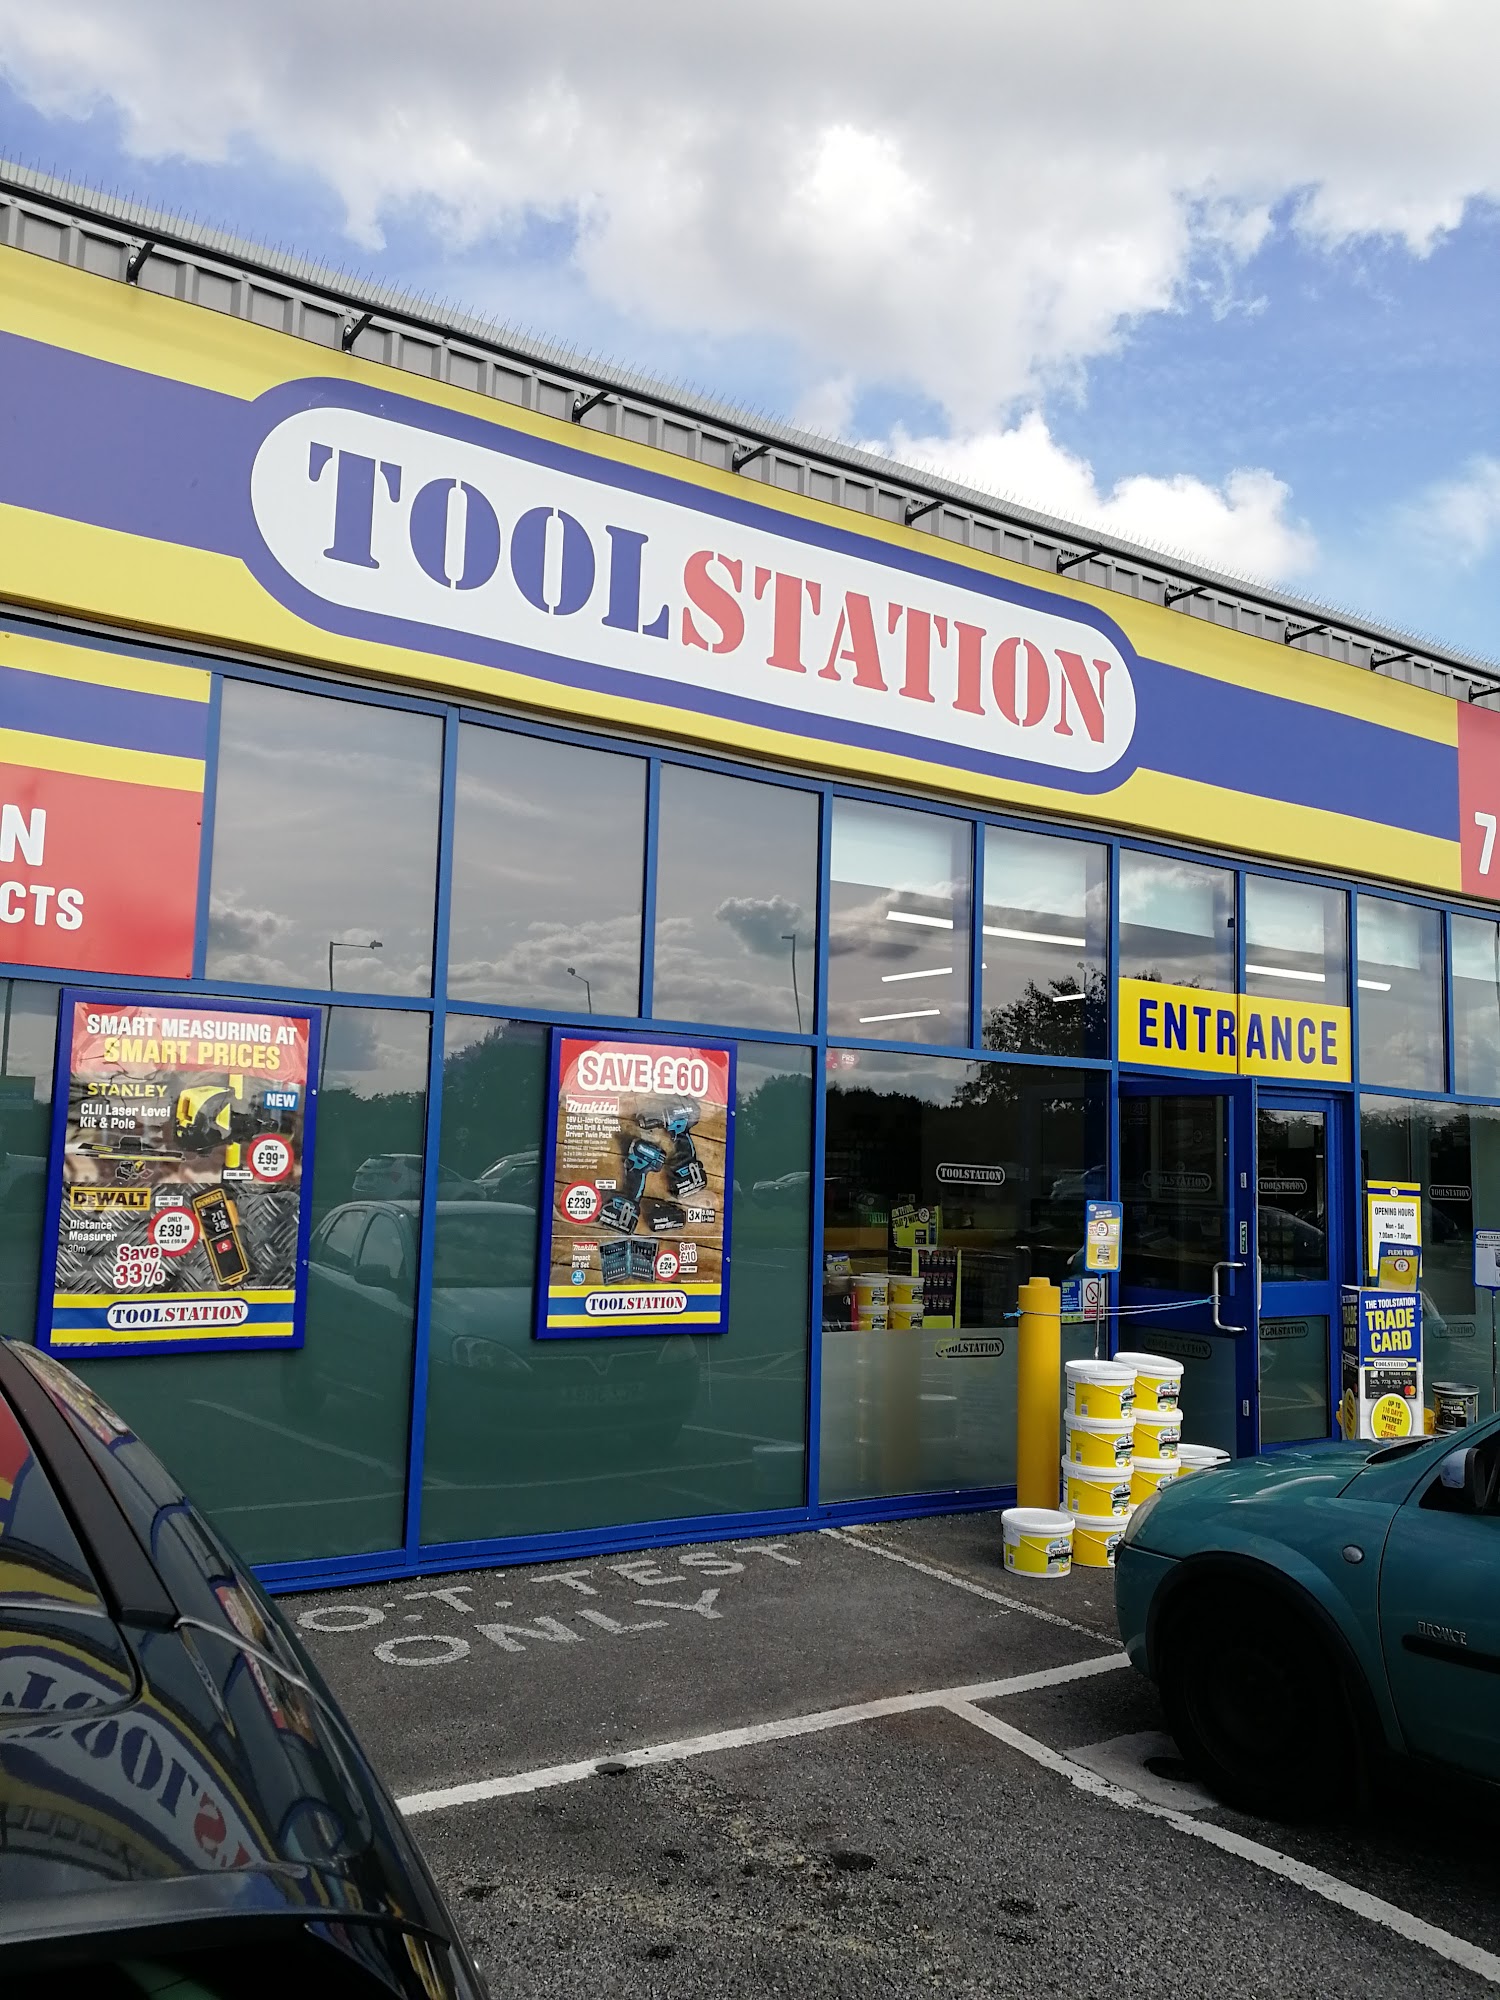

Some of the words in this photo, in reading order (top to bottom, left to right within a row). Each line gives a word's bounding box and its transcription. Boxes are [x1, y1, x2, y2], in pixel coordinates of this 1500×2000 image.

[309, 441, 1112, 744] TOOLSTATION
[1475, 811, 1497, 875] 7
[0, 880, 85, 931] CTS
[87, 1014, 156, 1037] SMART
[161, 1018, 271, 1043] MEASURING
[276, 1027, 297, 1046] AT
[1139, 998, 1338, 1065] ENTRANCE
[104, 1037, 191, 1064] SMART
[197, 1043, 281, 1070] PRICES
[582, 1055, 649, 1088] SAVE
[657, 1061, 702, 1092] £60
[87, 1083, 167, 1098] STANLEY
[266, 1093, 296, 1108] NEW
[105, 1104, 139, 1117] Laser
[141, 1106, 171, 1118] Level
[79, 1116, 98, 1128] Kit
[99, 1118, 108, 1129] &
[110, 1118, 136, 1130] Pole
[940, 1168, 1002, 1181] TOOLSTATION
[1374, 1206, 1397, 1216] OPENING
[1398, 1207, 1415, 1217] HOURS
[70, 1219, 112, 1231] Distance
[1385, 1222, 1394, 1230] Mon
[69, 1231, 117, 1242] Measurer
[118, 1245, 159, 1262] Save
[681, 1243, 695, 1251] Save
[680, 1252, 696, 1262] £10
[114, 1263, 163, 1286] 33%
[589, 1296, 684, 1311] TOOLSTATION
[1365, 1300, 1377, 1309] THE
[1378, 1296, 1416, 1308] TOOLSTATION
[112, 1305, 245, 1325] TOOLSTATION
[1365, 1307, 1415, 1331] TRADE
[1370, 1330, 1412, 1353] CARD
[1381, 1414, 1403, 1426] INTEREST
[1385, 1423, 1396, 1432] FREE
[531, 1543, 800, 1595] TEST
[372, 1588, 722, 1667] ONLY
